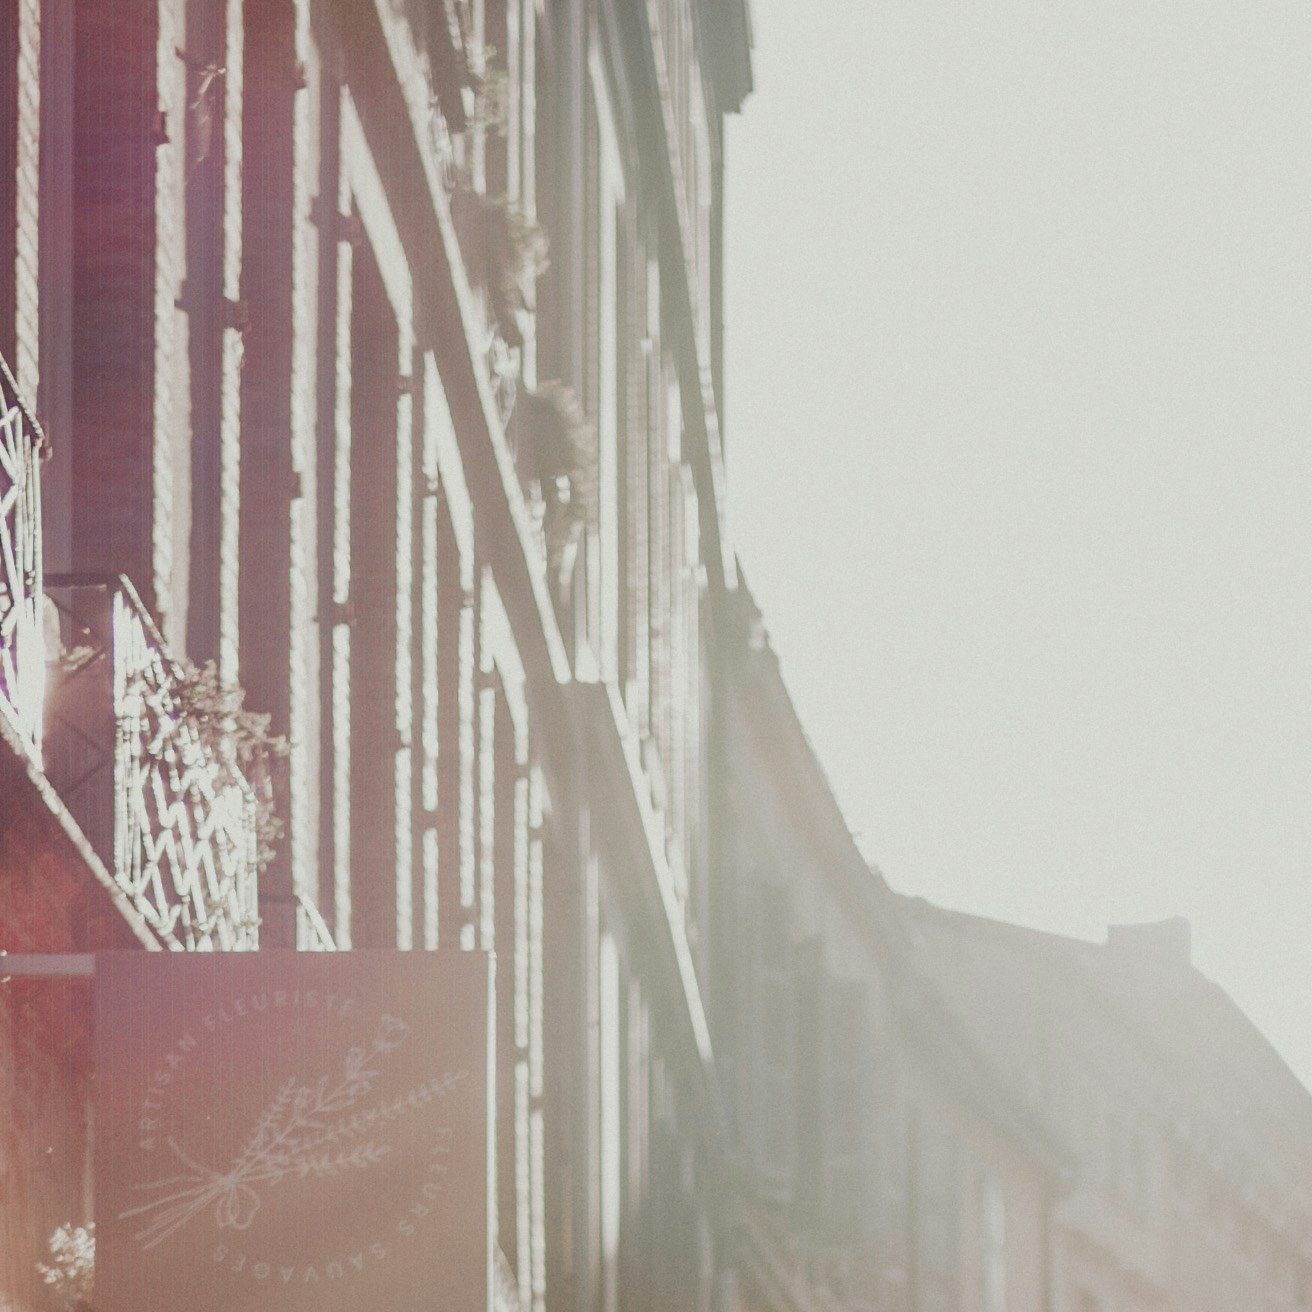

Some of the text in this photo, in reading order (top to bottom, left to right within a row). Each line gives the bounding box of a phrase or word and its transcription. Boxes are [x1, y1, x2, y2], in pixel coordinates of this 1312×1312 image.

[139, 989, 355, 1152] ARTISAN FLEURISTE
[397, 1125, 454, 1237] FLEURS
